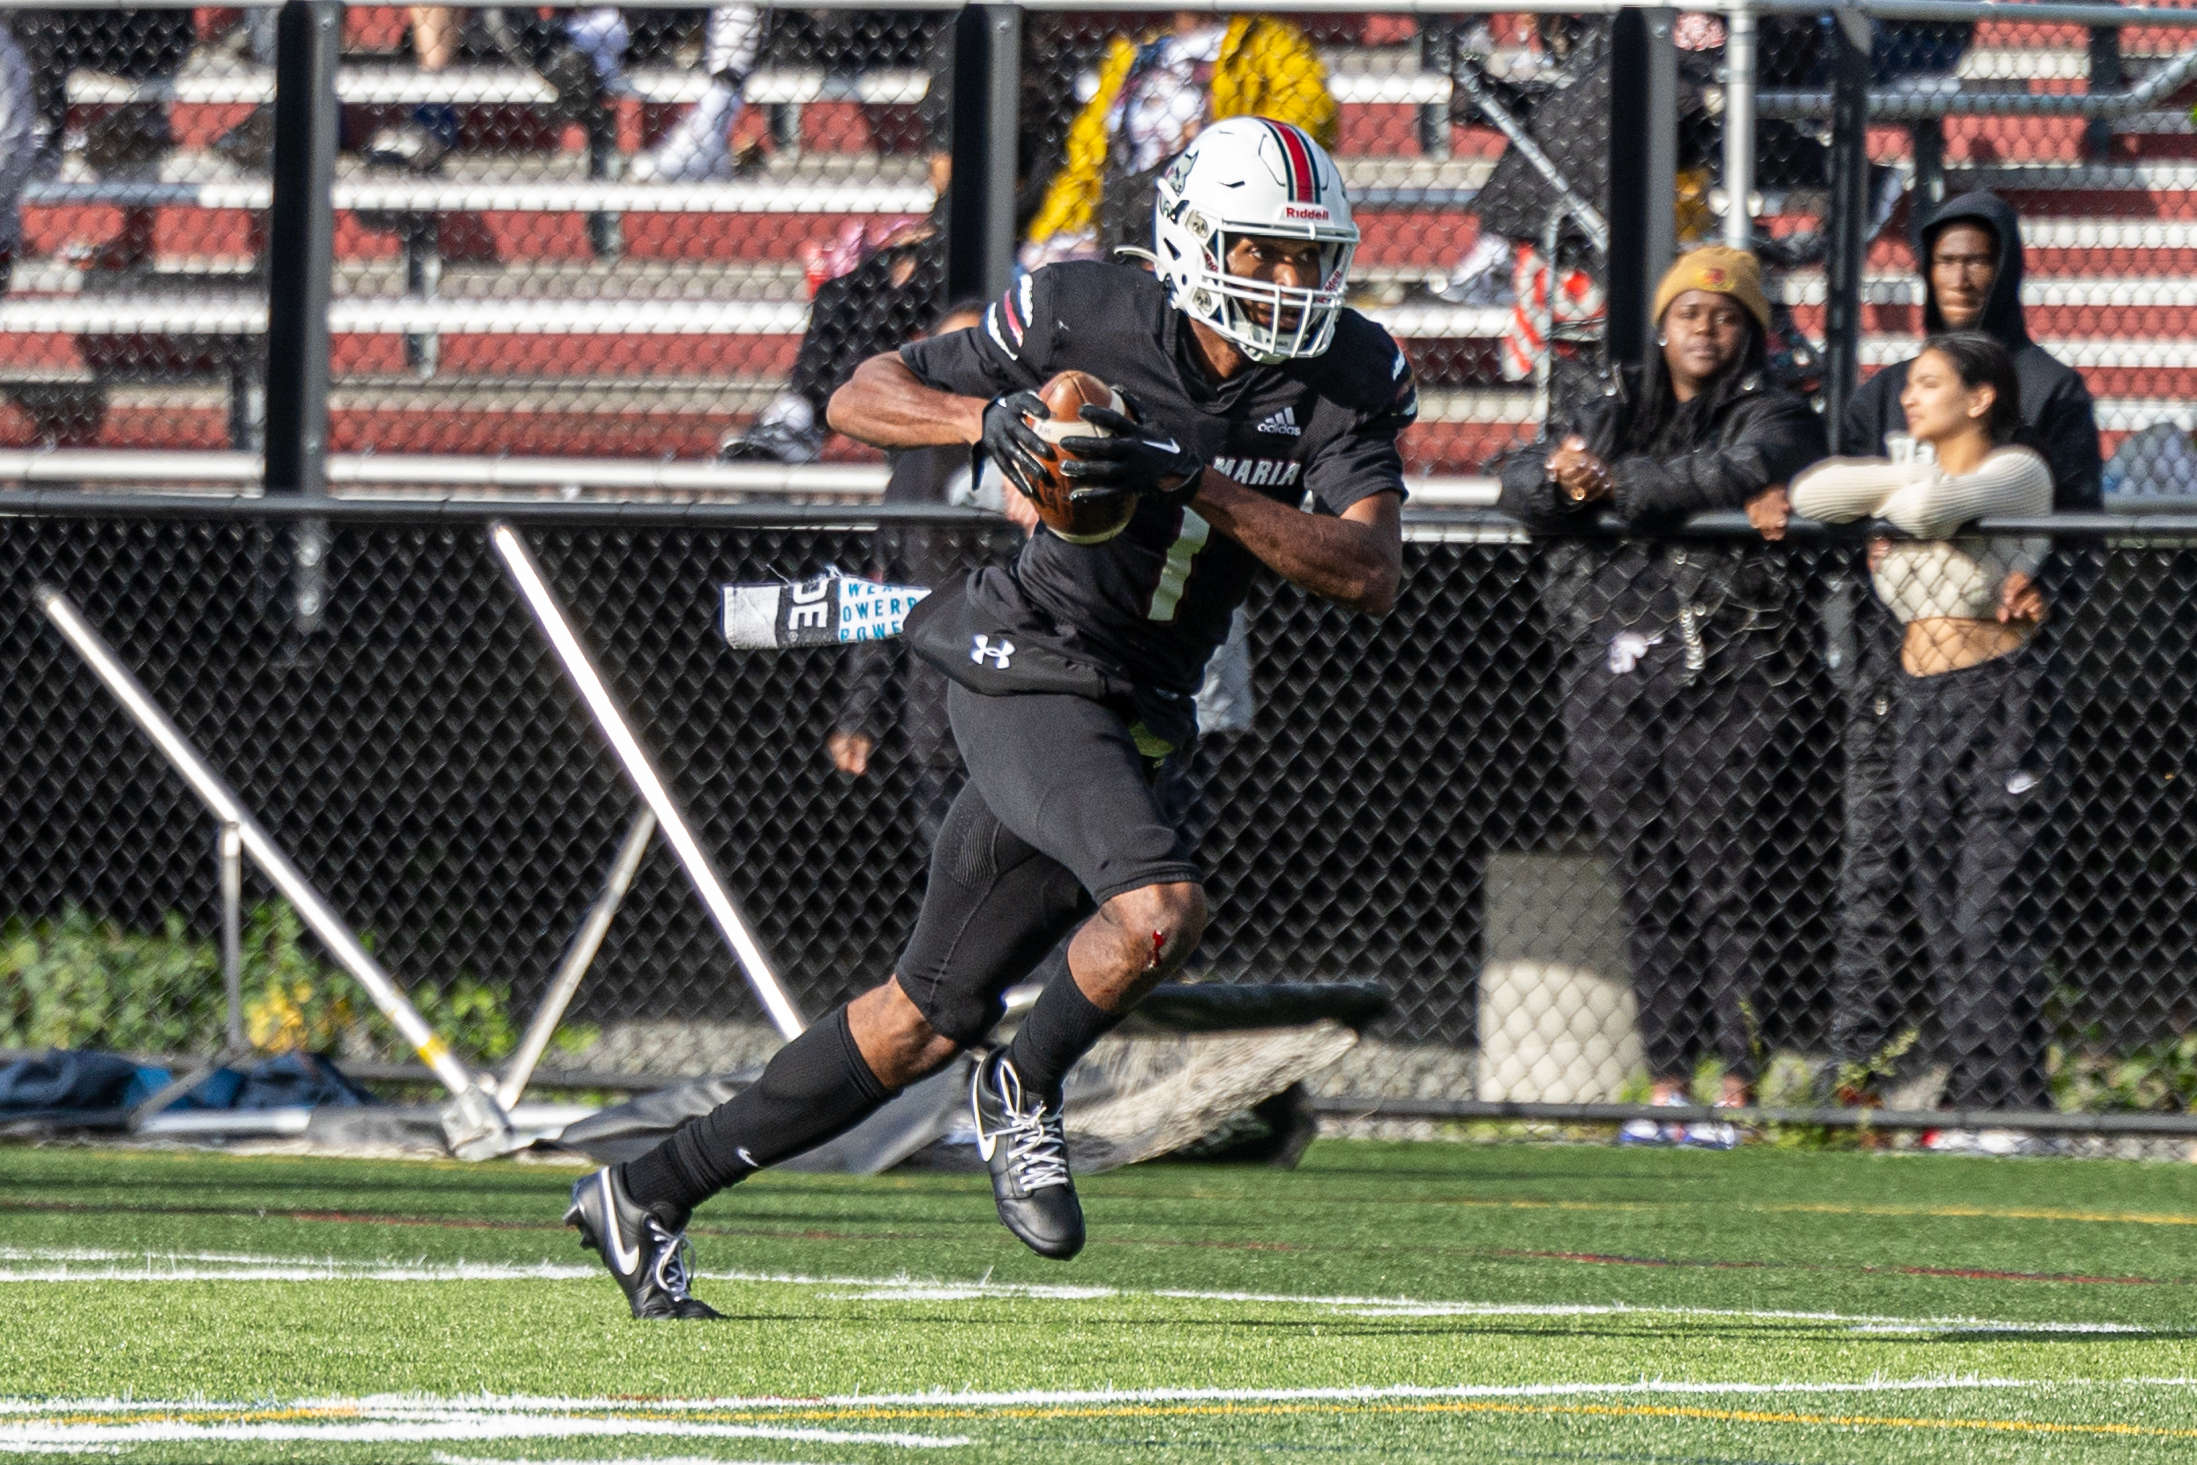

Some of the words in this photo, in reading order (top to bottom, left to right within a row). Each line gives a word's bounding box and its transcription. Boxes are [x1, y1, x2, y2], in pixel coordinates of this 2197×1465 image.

[1286, 207, 1329, 220] Riddell
[1257, 423, 1301, 436] adidas
[1213, 456, 1301, 486] MARIA
